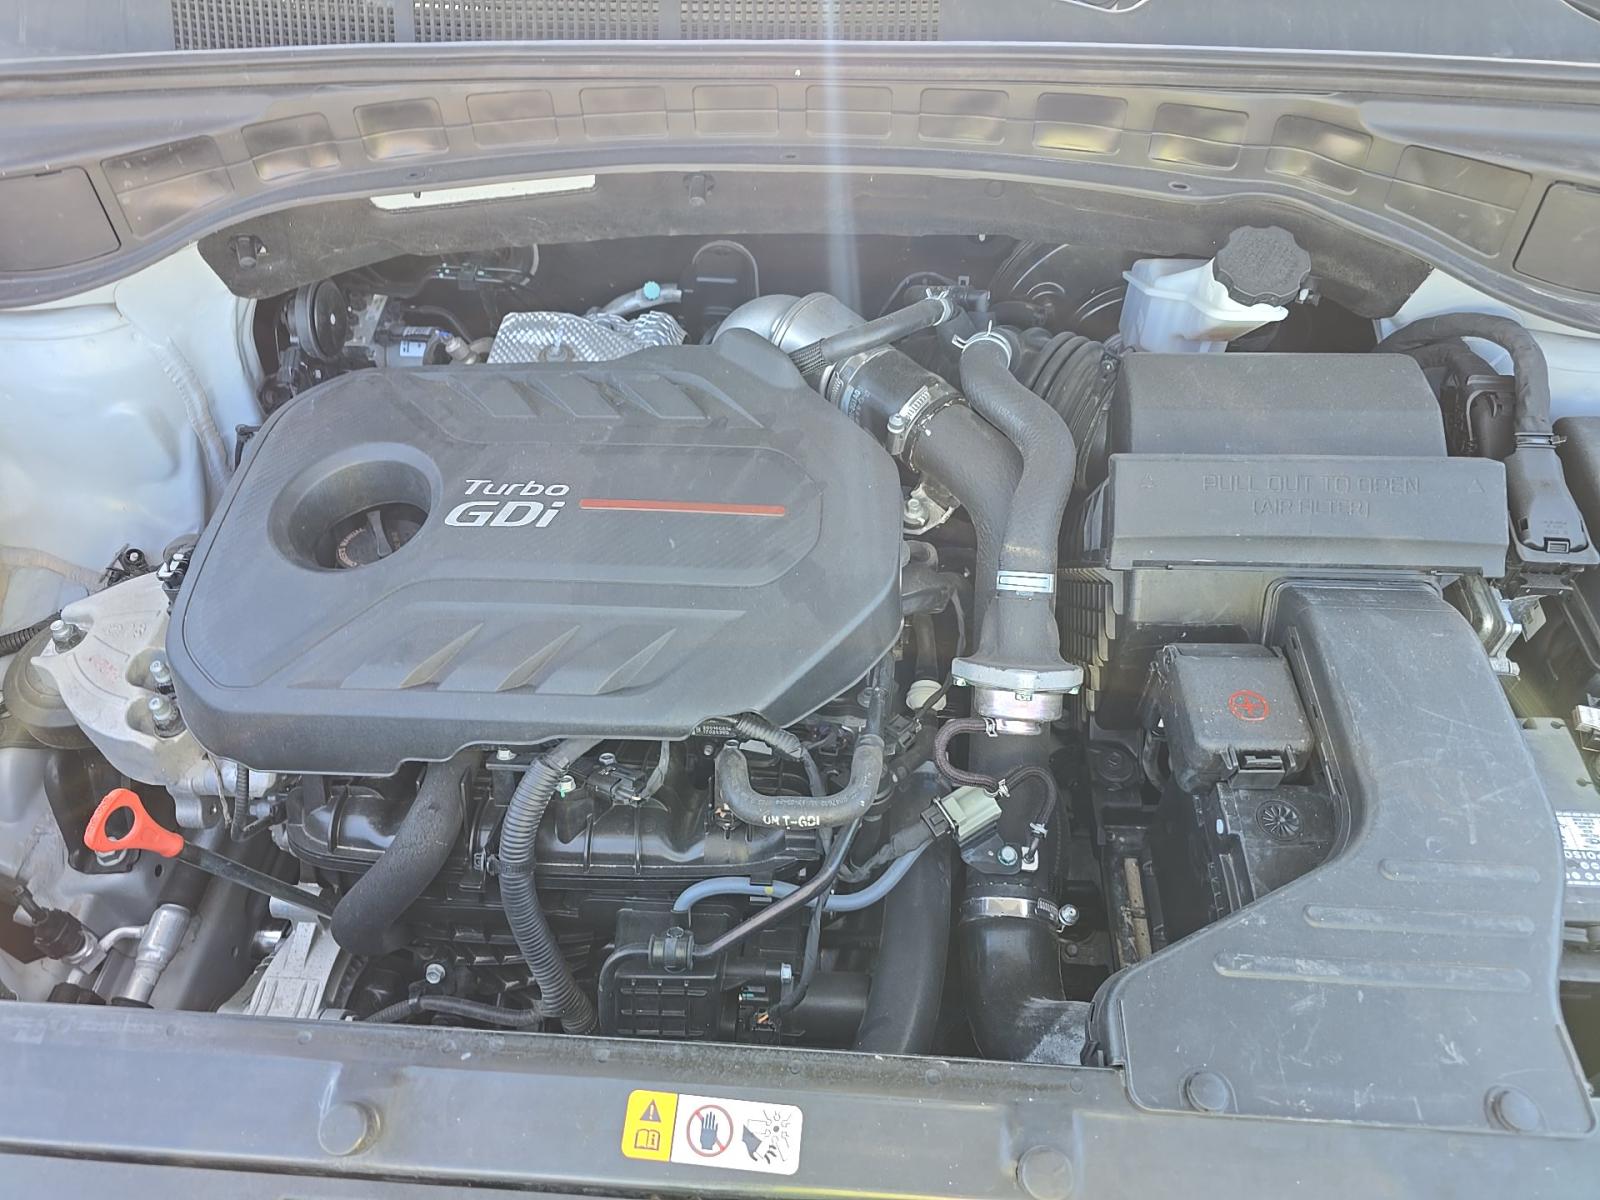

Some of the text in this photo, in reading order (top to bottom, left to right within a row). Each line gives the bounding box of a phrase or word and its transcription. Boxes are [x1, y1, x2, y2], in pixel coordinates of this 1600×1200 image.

[464, 479, 570, 496] Turbo
[1201, 473, 1420, 495] PULL OUT TO OPEN
[444, 500, 566, 528] GDi
